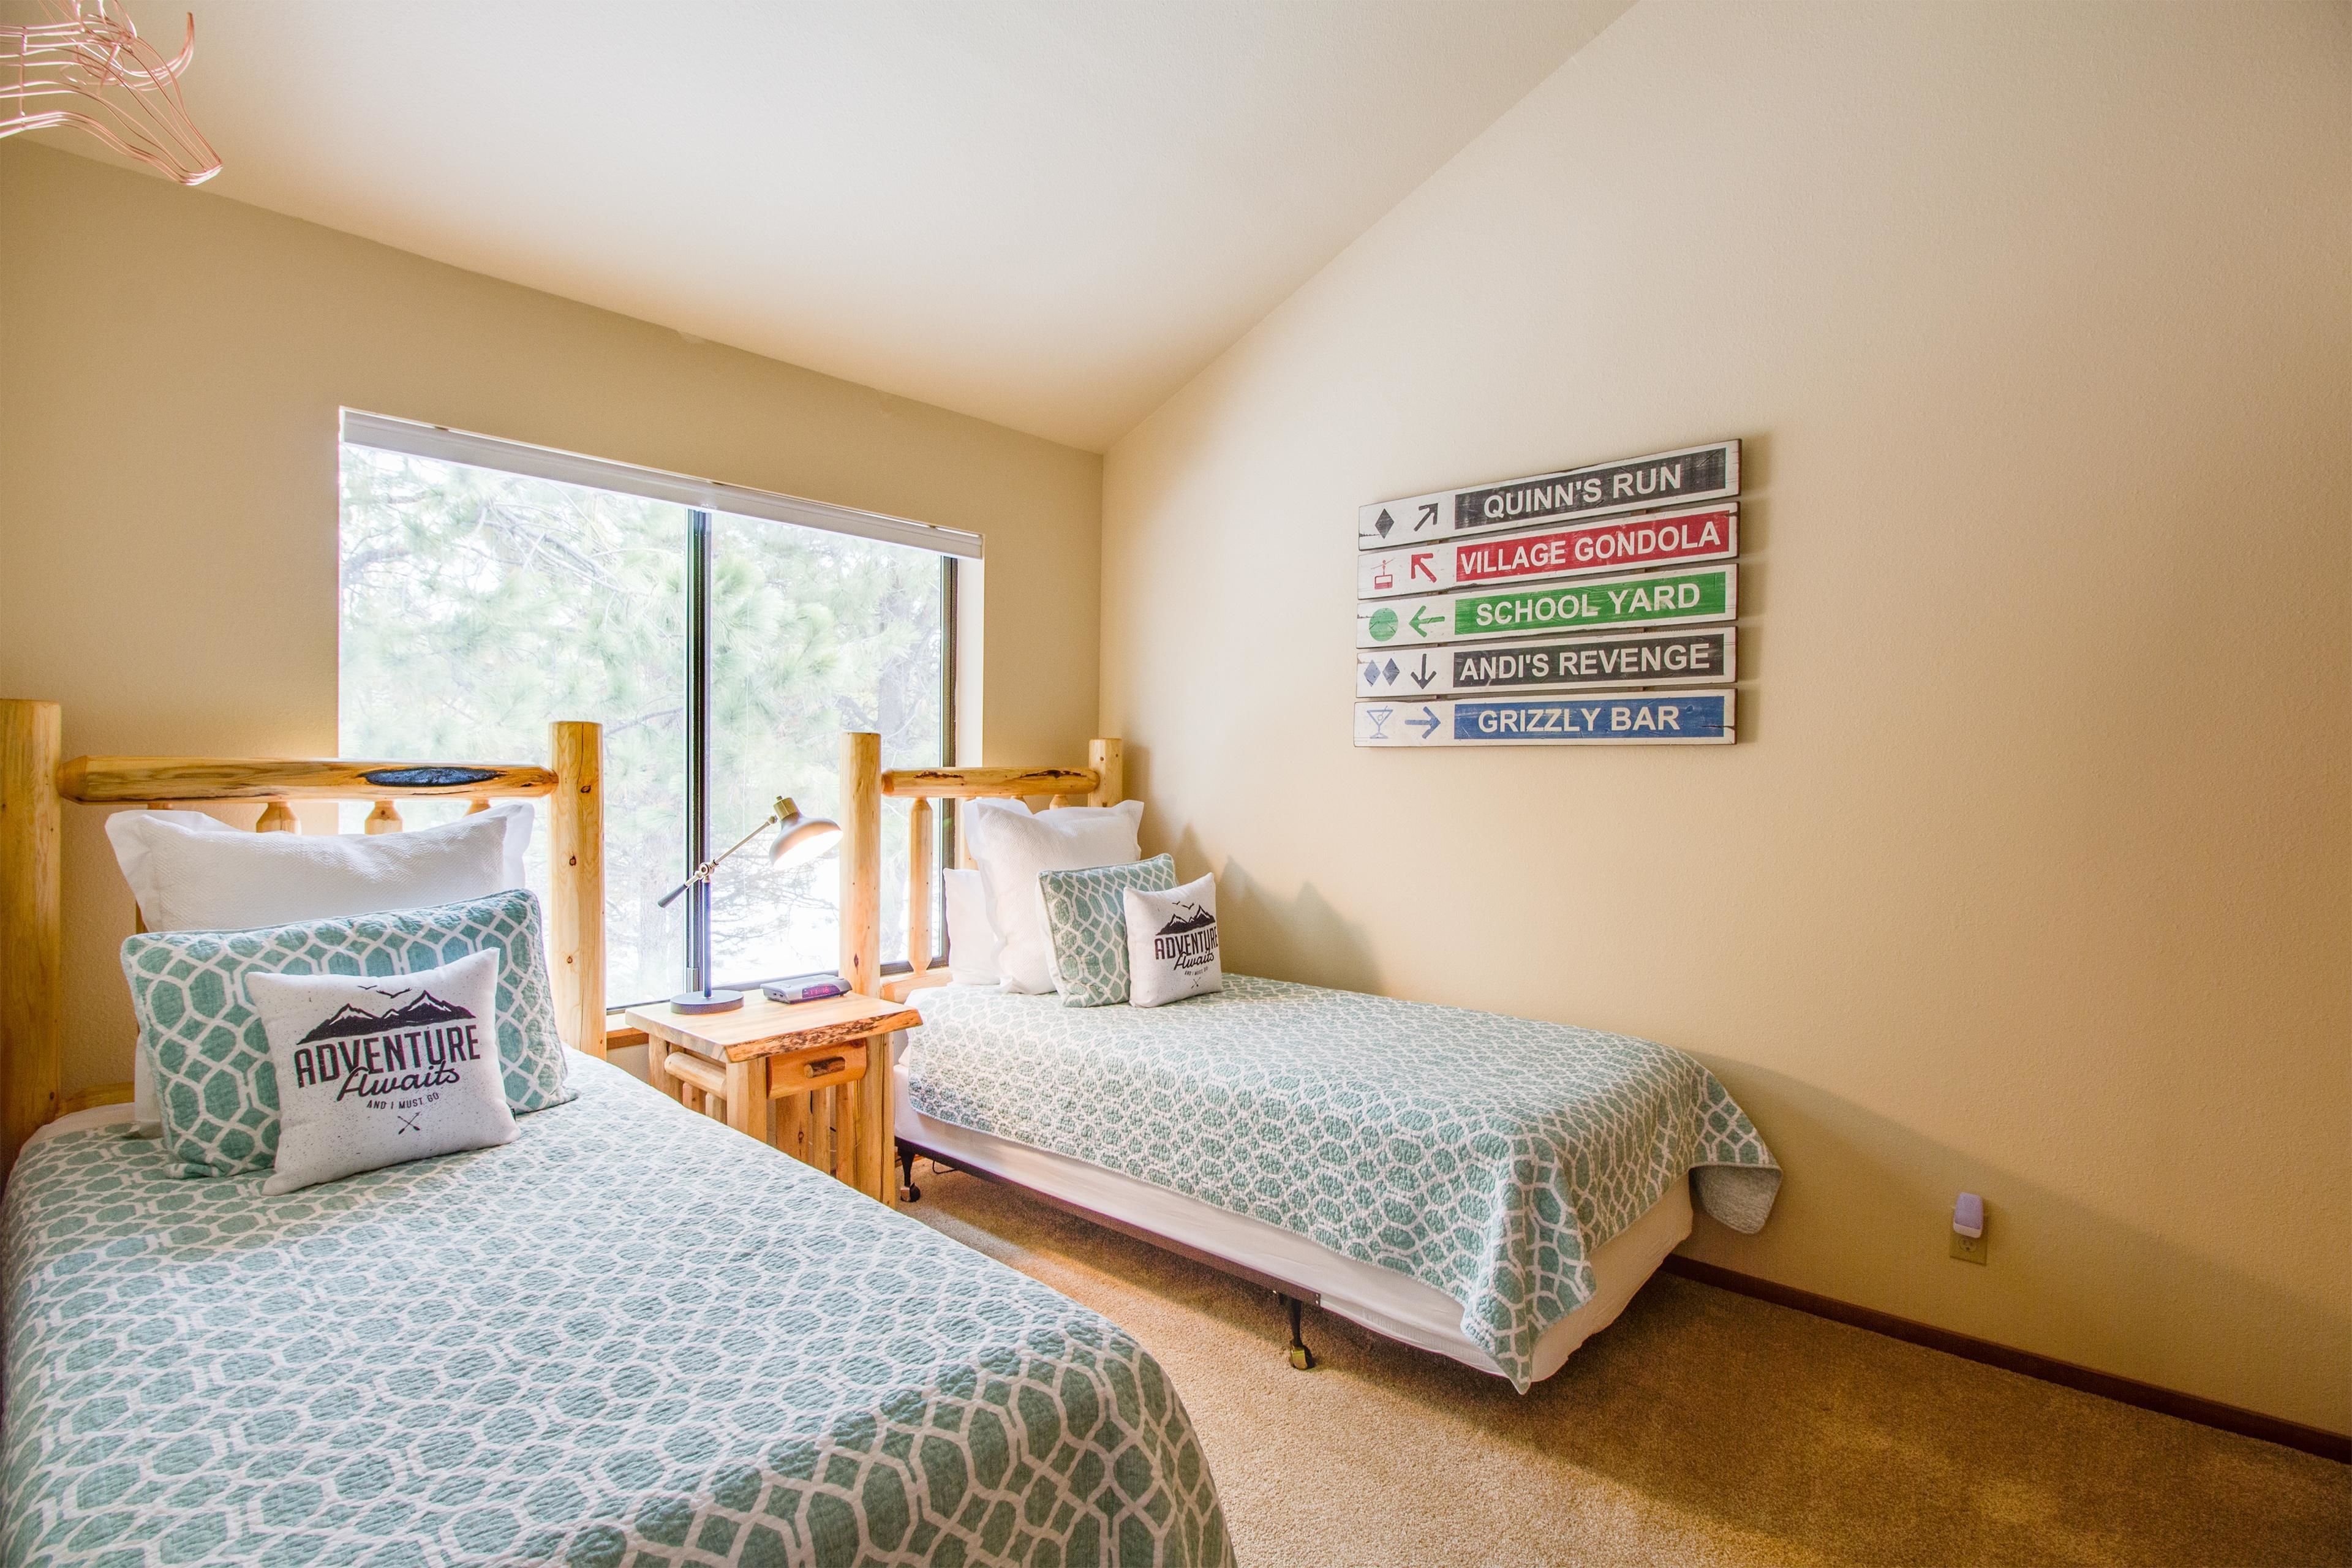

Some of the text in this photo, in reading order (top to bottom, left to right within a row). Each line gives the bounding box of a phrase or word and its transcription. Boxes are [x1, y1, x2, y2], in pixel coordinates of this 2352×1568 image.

[1483, 464, 1682, 519] QUINN'S RUN
[1460, 521, 1721, 575] VILLAGE GONDOLA
[1476, 582, 1700, 626] SCHOOL YARD
[1460, 643, 1710, 681] ANDI'S REVENGE
[1478, 706, 1680, 734] GRIZZLY BAR
[1154, 925, 1218, 960] ADVENTURE
[1173, 949, 1215, 970] Awaits
[293, 1024, 481, 1088] ADVENTURE
[336, 1060, 461, 1101] Awaits
[367, 1099, 387, 1109] AND
[399, 1098, 423, 1109] MUST
[427, 1092, 440, 1102] GO
